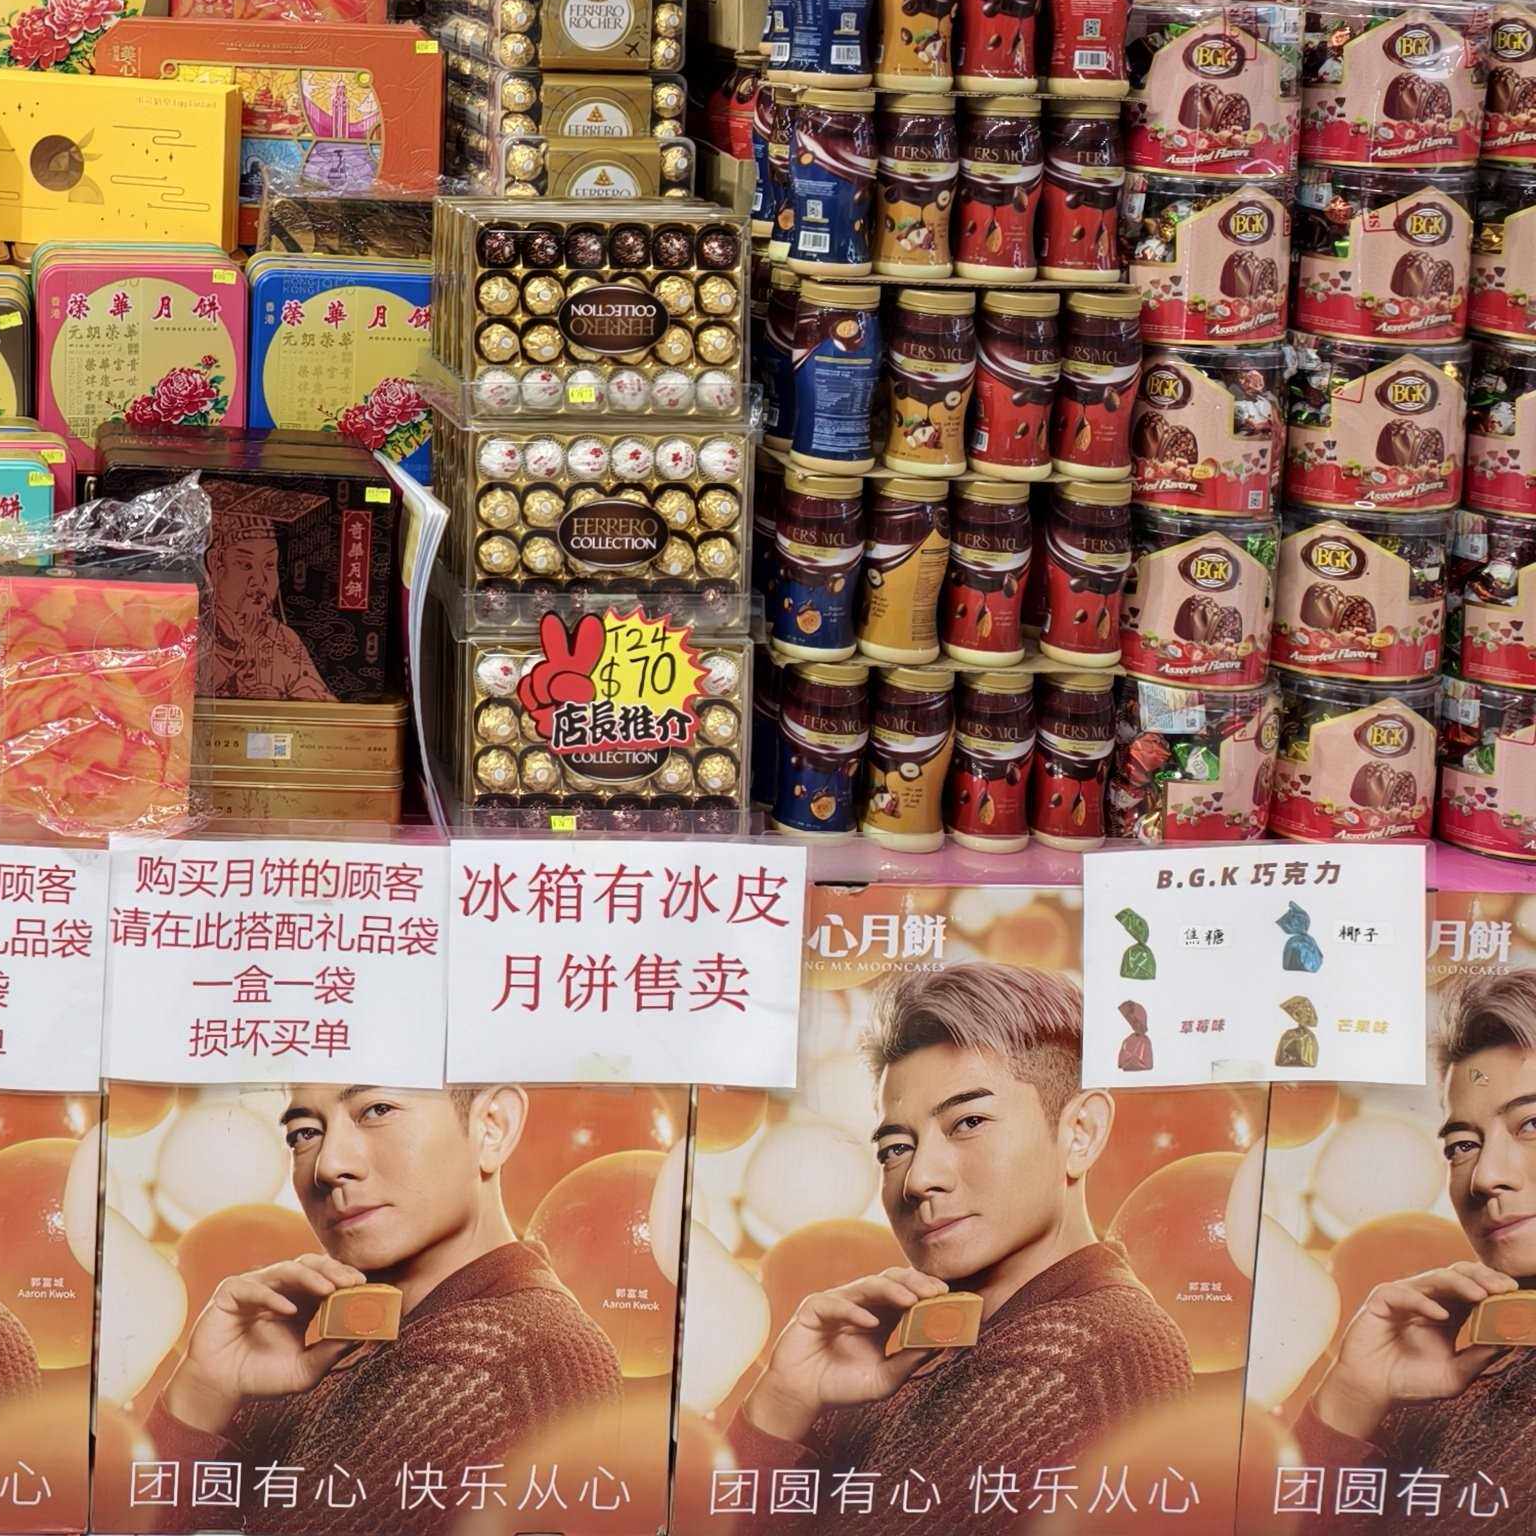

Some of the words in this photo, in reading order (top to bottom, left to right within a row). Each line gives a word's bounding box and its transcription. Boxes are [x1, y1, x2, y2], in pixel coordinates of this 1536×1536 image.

[568, 5, 625, 19] FERRERO
[568, 16, 624, 30] ROCHER
[1198, 47, 1237, 68] BGK
[67, 292, 222, 325] 榮華月餅
[281, 300, 432, 331] 榮華月餅
[570, 303, 657, 317] COLLECTION
[572, 517, 658, 537] FERRERO
[570, 536, 657, 550] COLLECTION
[348, 520, 365, 601] 奇華月餅
[605, 626, 673, 654] T24
[598, 653, 676, 701] $70
[550, 701, 694, 748] 店長推介
[571, 750, 658, 764] COLLECTION
[133, 856, 425, 905] 购买月饼的顾客
[1155, 864, 1240, 891] B.G.K
[1250, 860, 1343, 889] 巧克力
[459, 862, 792, 928] 冰箱有冰皮
[109, 906, 440, 957] 请在此搭配礼品袋
[807, 913, 947, 962] 心月餅
[1182, 925, 1226, 948] 焦糖
[1337, 922, 1381, 944] 椰子
[1427, 920, 1513, 965] 月餅
[855, 960, 946, 973] MOONCAKES
[192, 964, 357, 1006] 一盒一袋
[490, 951, 750, 1014] 月饼售卖
[188, 1017, 351, 1060] 损坏买单
[1179, 1018, 1228, 1036] 草莓味
[1336, 1016, 1391, 1037] 芒果味
[17, 1289, 46, 1300] Aaron
[48, 1289, 77, 1300] Kwok
[127, 1458, 370, 1511] 团圆有心
[394, 1463, 632, 1514] 快乐从心
[707, 1465, 945, 1520] 团圆有心
[969, 1465, 1203, 1517] 快乐从心
[1271, 1465, 1513, 1519] 团圆有心
